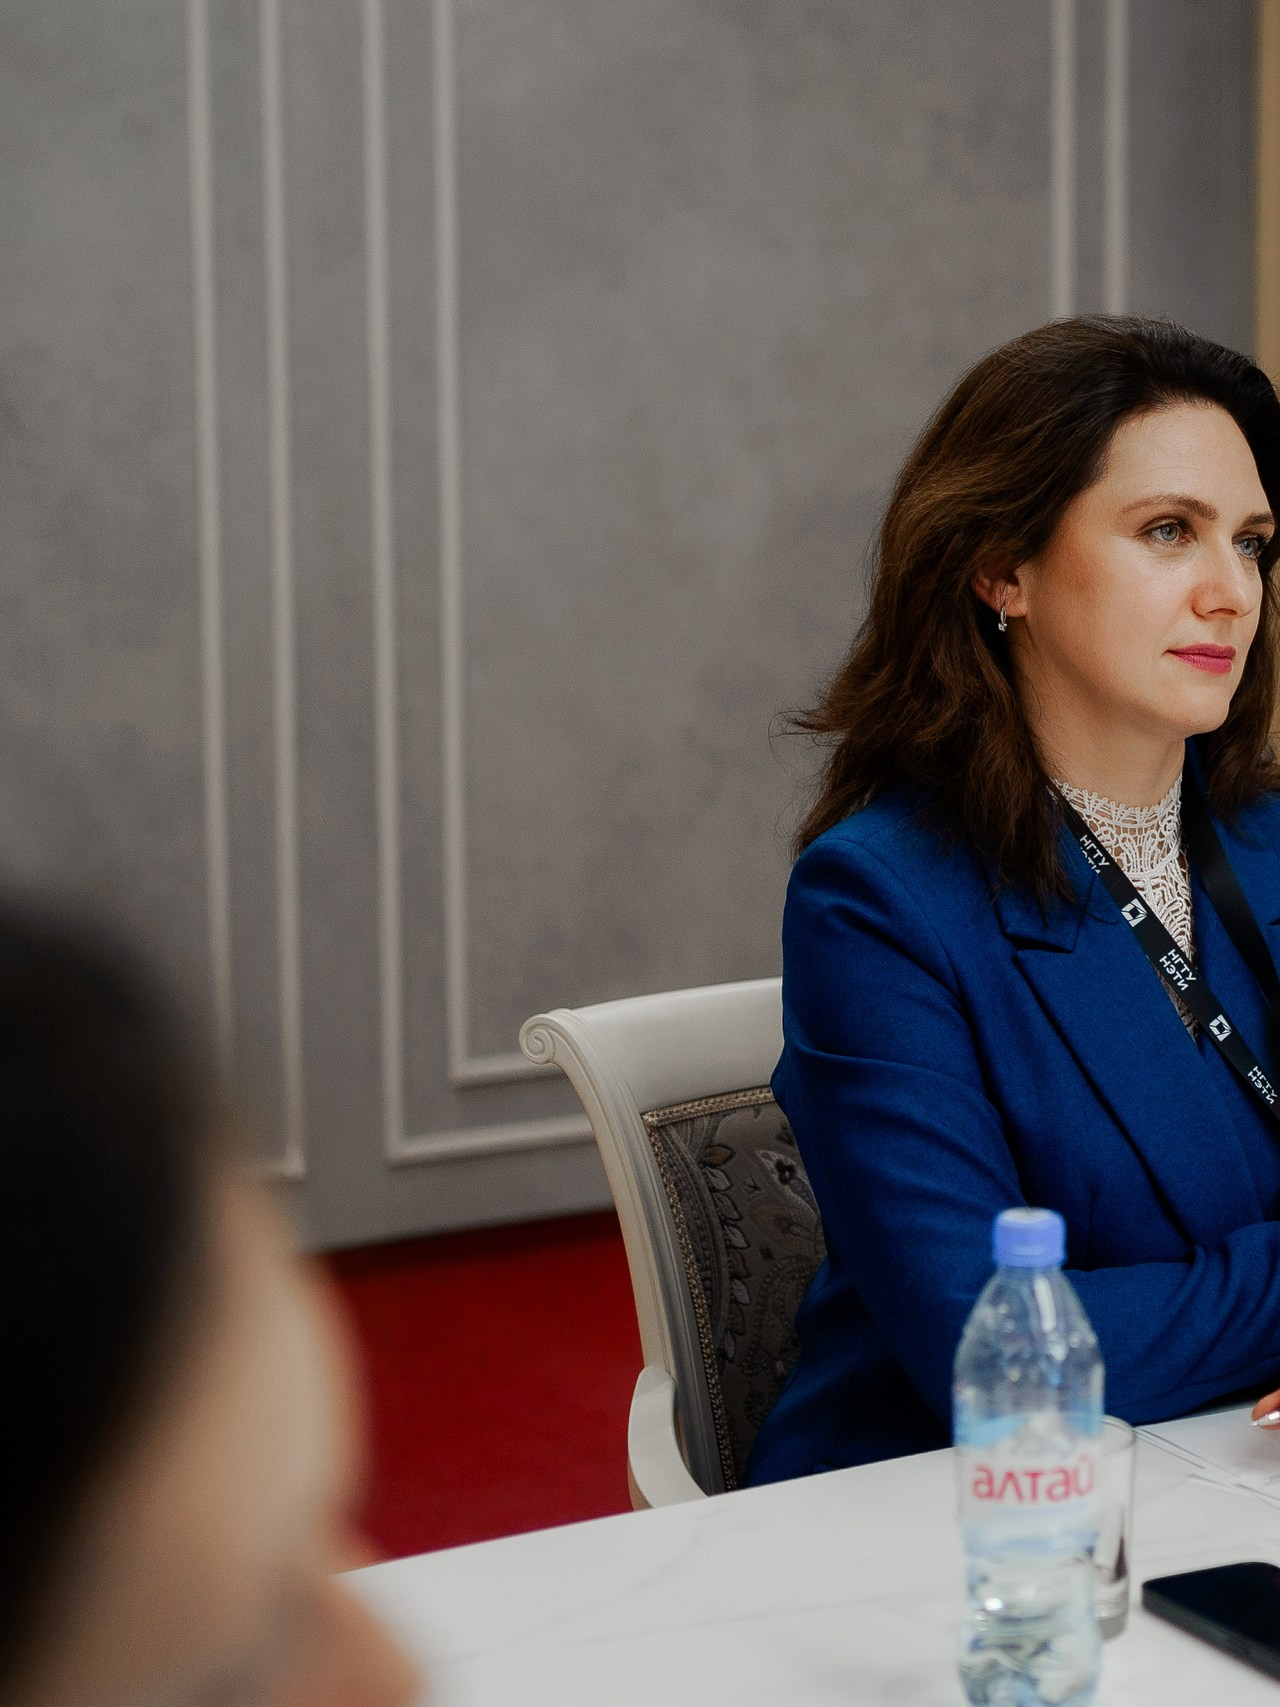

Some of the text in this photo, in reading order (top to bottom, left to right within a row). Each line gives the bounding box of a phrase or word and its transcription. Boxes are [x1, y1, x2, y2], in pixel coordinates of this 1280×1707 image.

[1079, 834, 1110, 866] НГТУ
[1159, 955, 1189, 991] НЭТИ
[1167, 949, 1197, 981] НГТУ
[1247, 1071, 1275, 1105] НЭТИ
[1252, 1065, 1278, 1098] НГТУ
